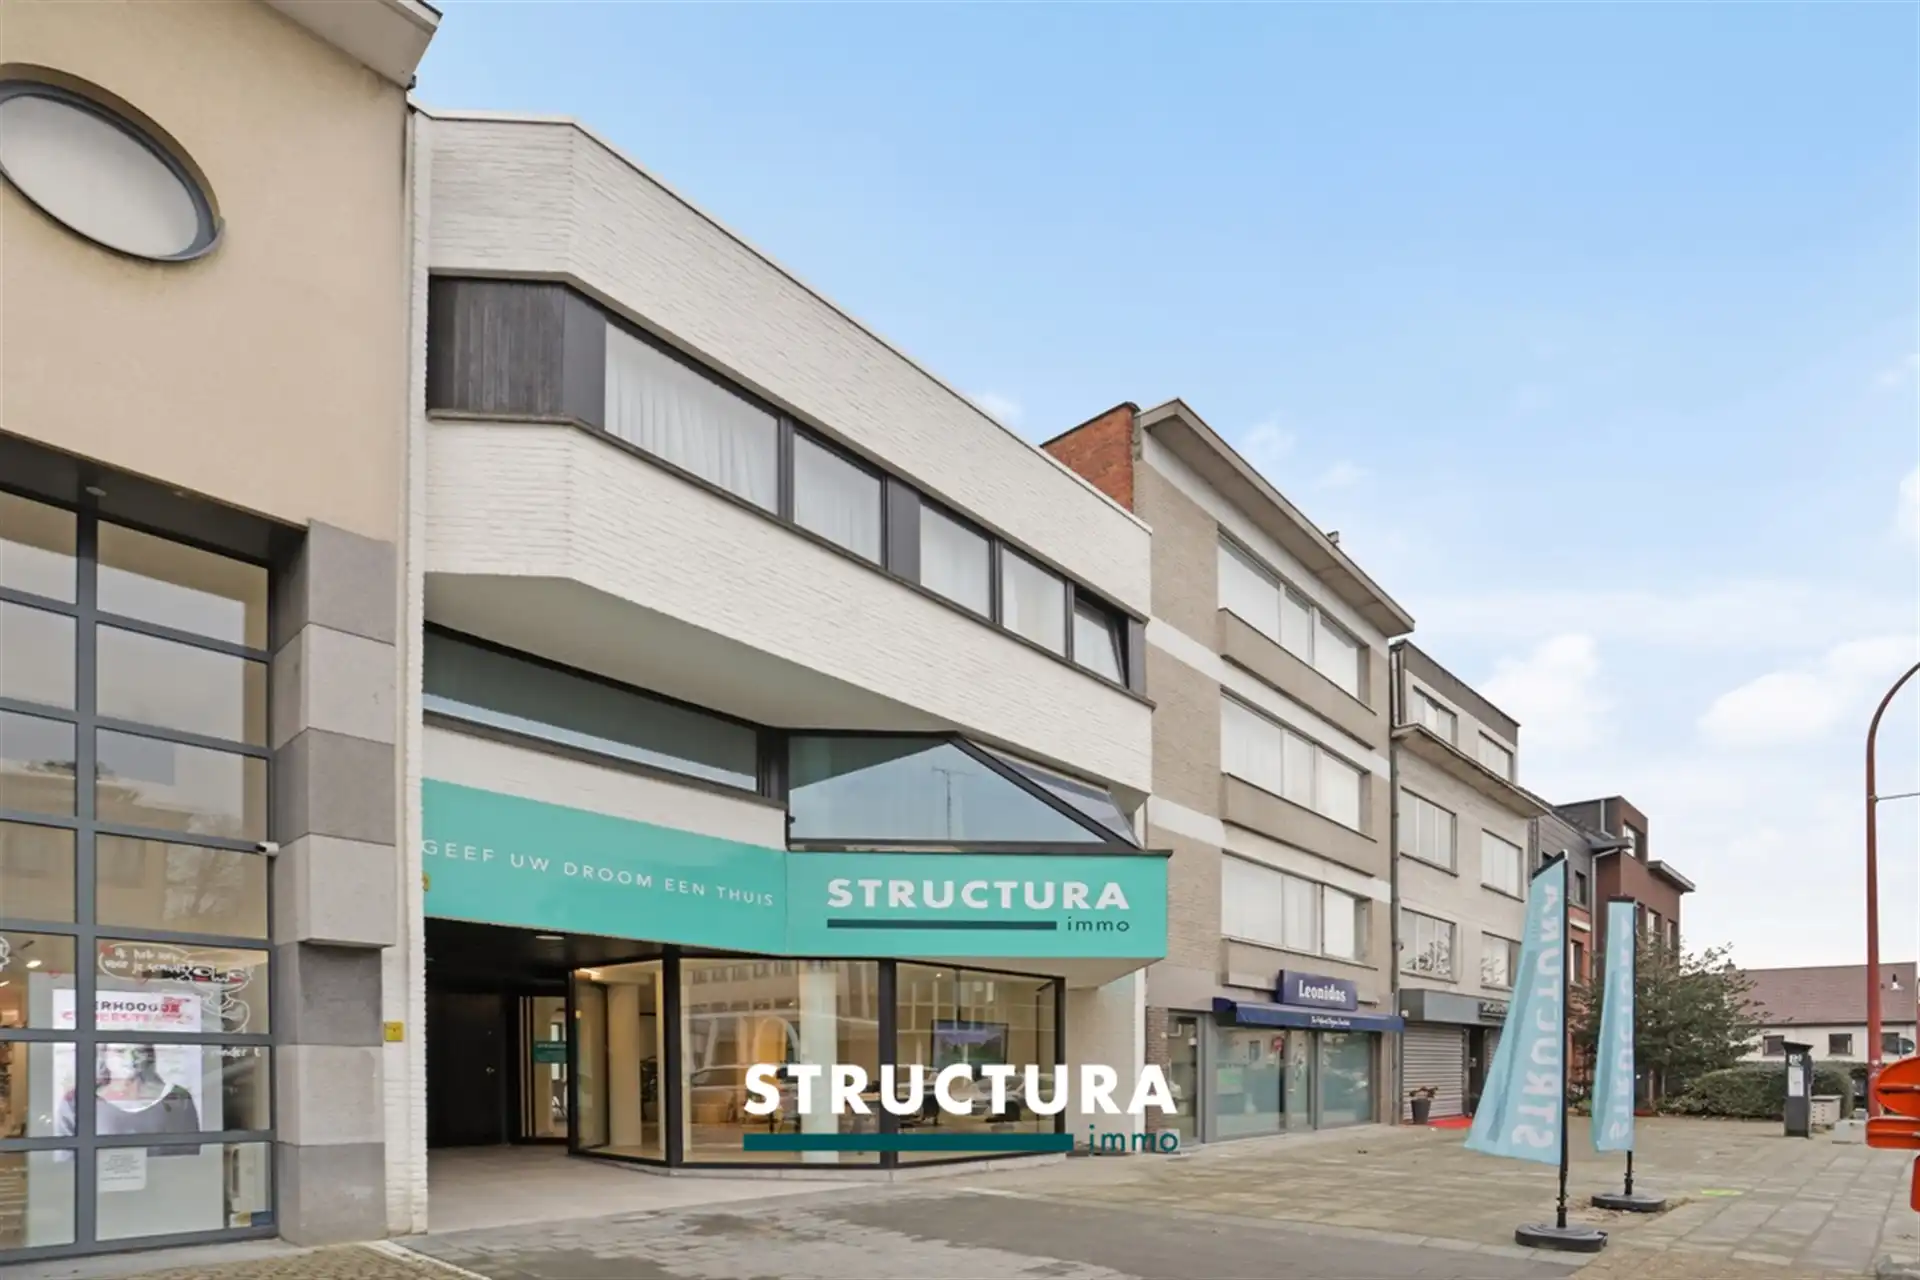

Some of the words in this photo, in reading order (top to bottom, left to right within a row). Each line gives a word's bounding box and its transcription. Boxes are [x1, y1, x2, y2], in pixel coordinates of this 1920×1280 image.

[421, 839, 496, 862] GEEF
[510, 852, 549, 872] UW
[563, 862, 652, 888] DROOM
[665, 878, 706, 896] EEN
[716, 885, 774, 907] THUIS
[826, 878, 1131, 910] STRUCTURA
[1067, 916, 1131, 933] immo
[1298, 979, 1347, 1002] Leonidas
